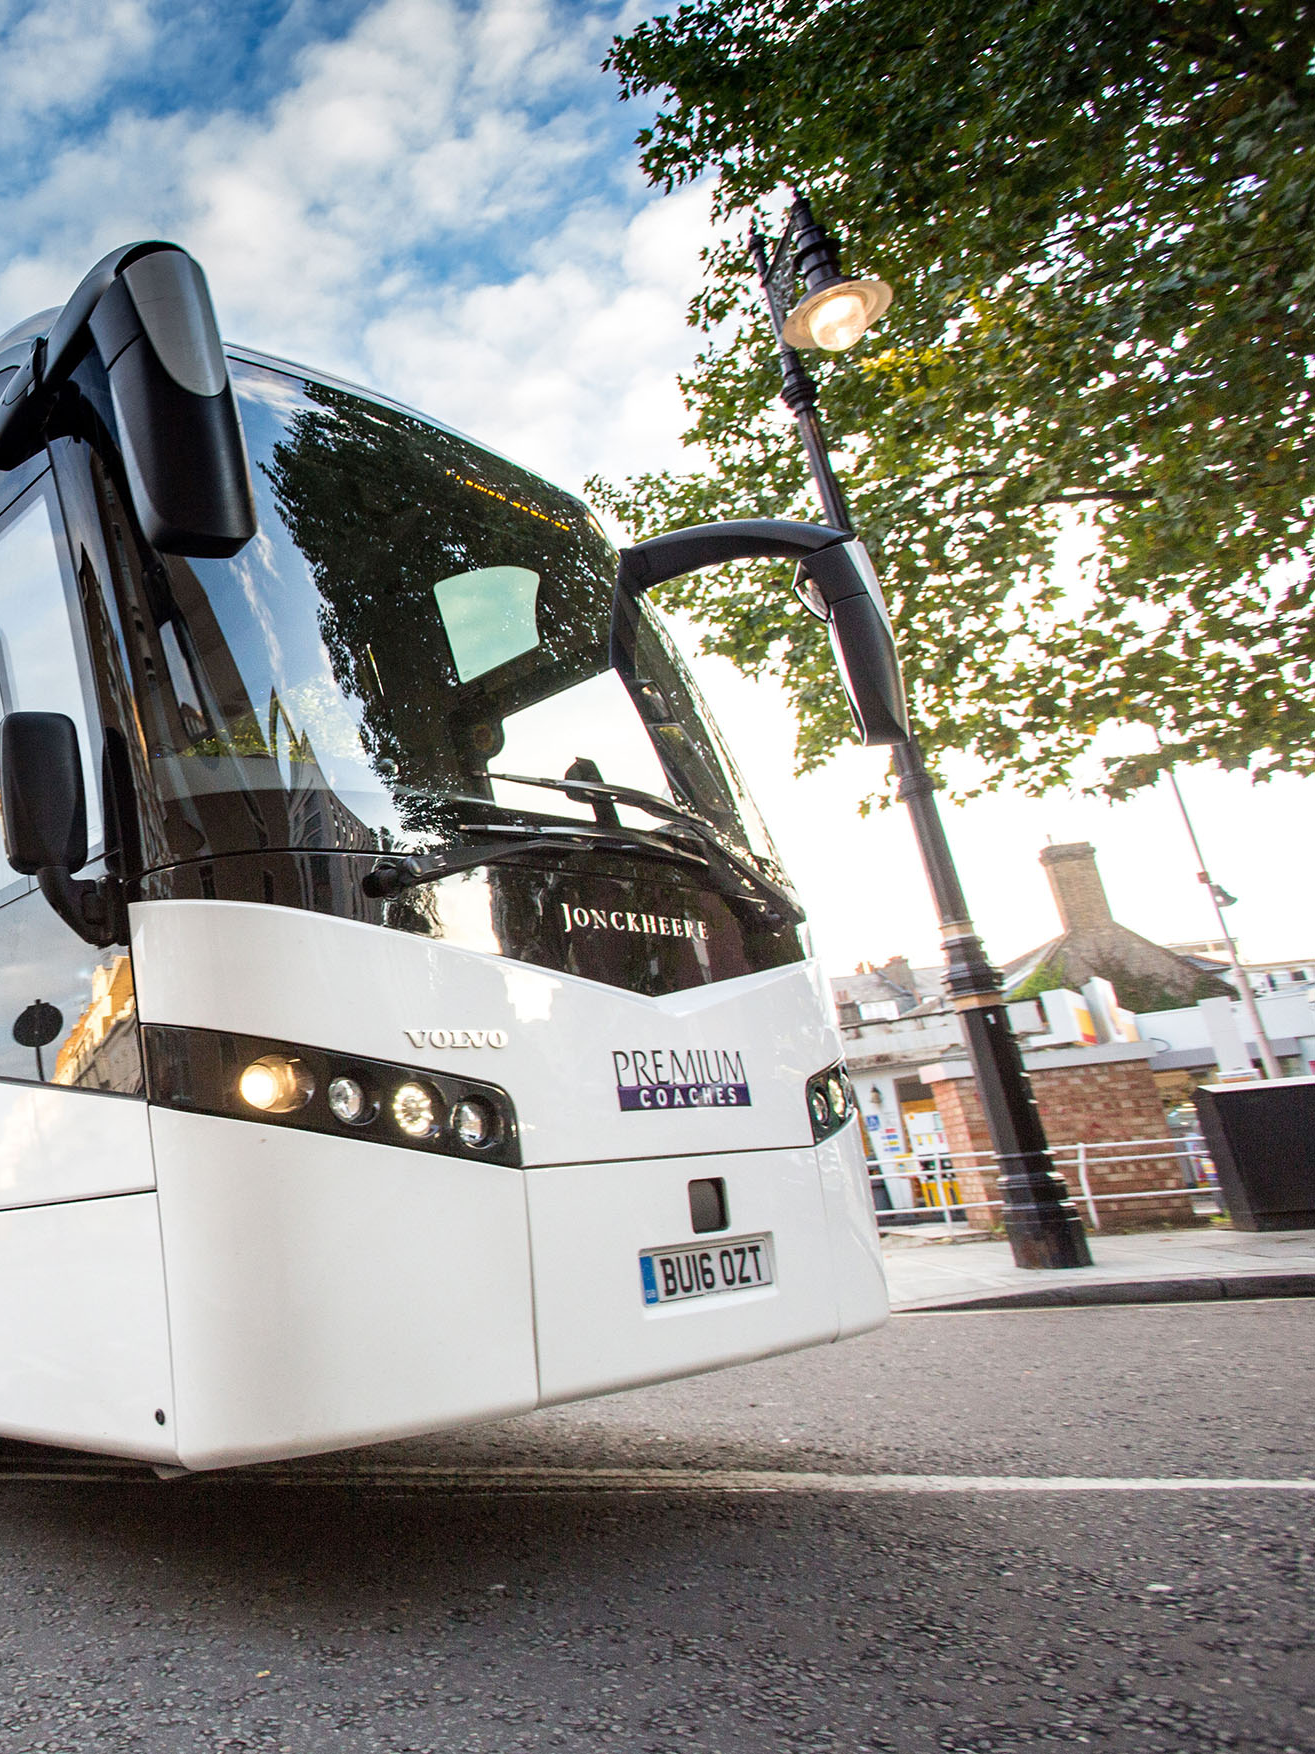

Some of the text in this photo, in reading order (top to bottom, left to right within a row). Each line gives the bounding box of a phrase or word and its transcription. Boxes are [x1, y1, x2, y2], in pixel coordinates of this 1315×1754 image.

[560, 903, 708, 943] JONCKHEERE
[402, 1029, 508, 1050] VOLVO
[612, 1050, 746, 1087] PREMIUM
[639, 1087, 738, 1107] COACHES
[660, 1245, 761, 1296] BU16 OZT
